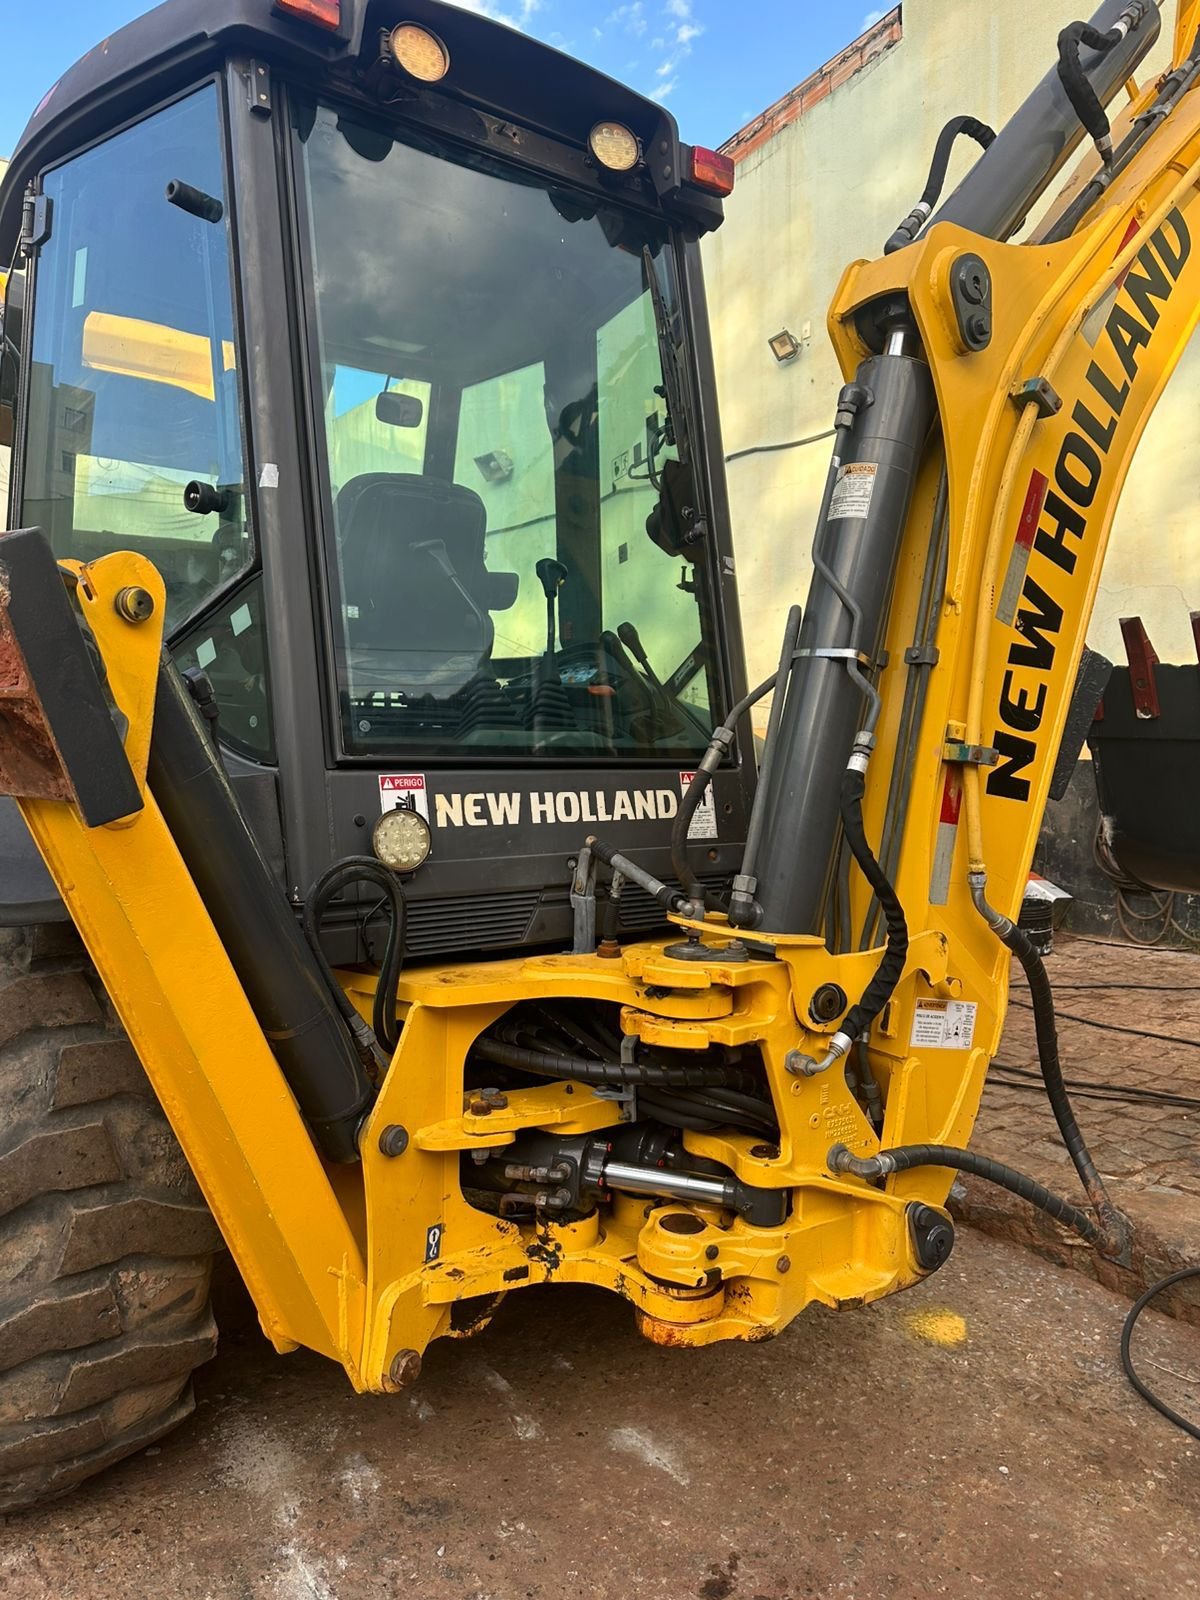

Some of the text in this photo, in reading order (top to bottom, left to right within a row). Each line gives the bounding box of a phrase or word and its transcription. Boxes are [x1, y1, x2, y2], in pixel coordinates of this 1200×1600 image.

[986, 207, 1191, 802] NEW HOLLAND
[394, 778, 423, 788] PERIGO
[434, 792, 521, 828] NEW
[529, 789, 679, 824] HOLLAND
